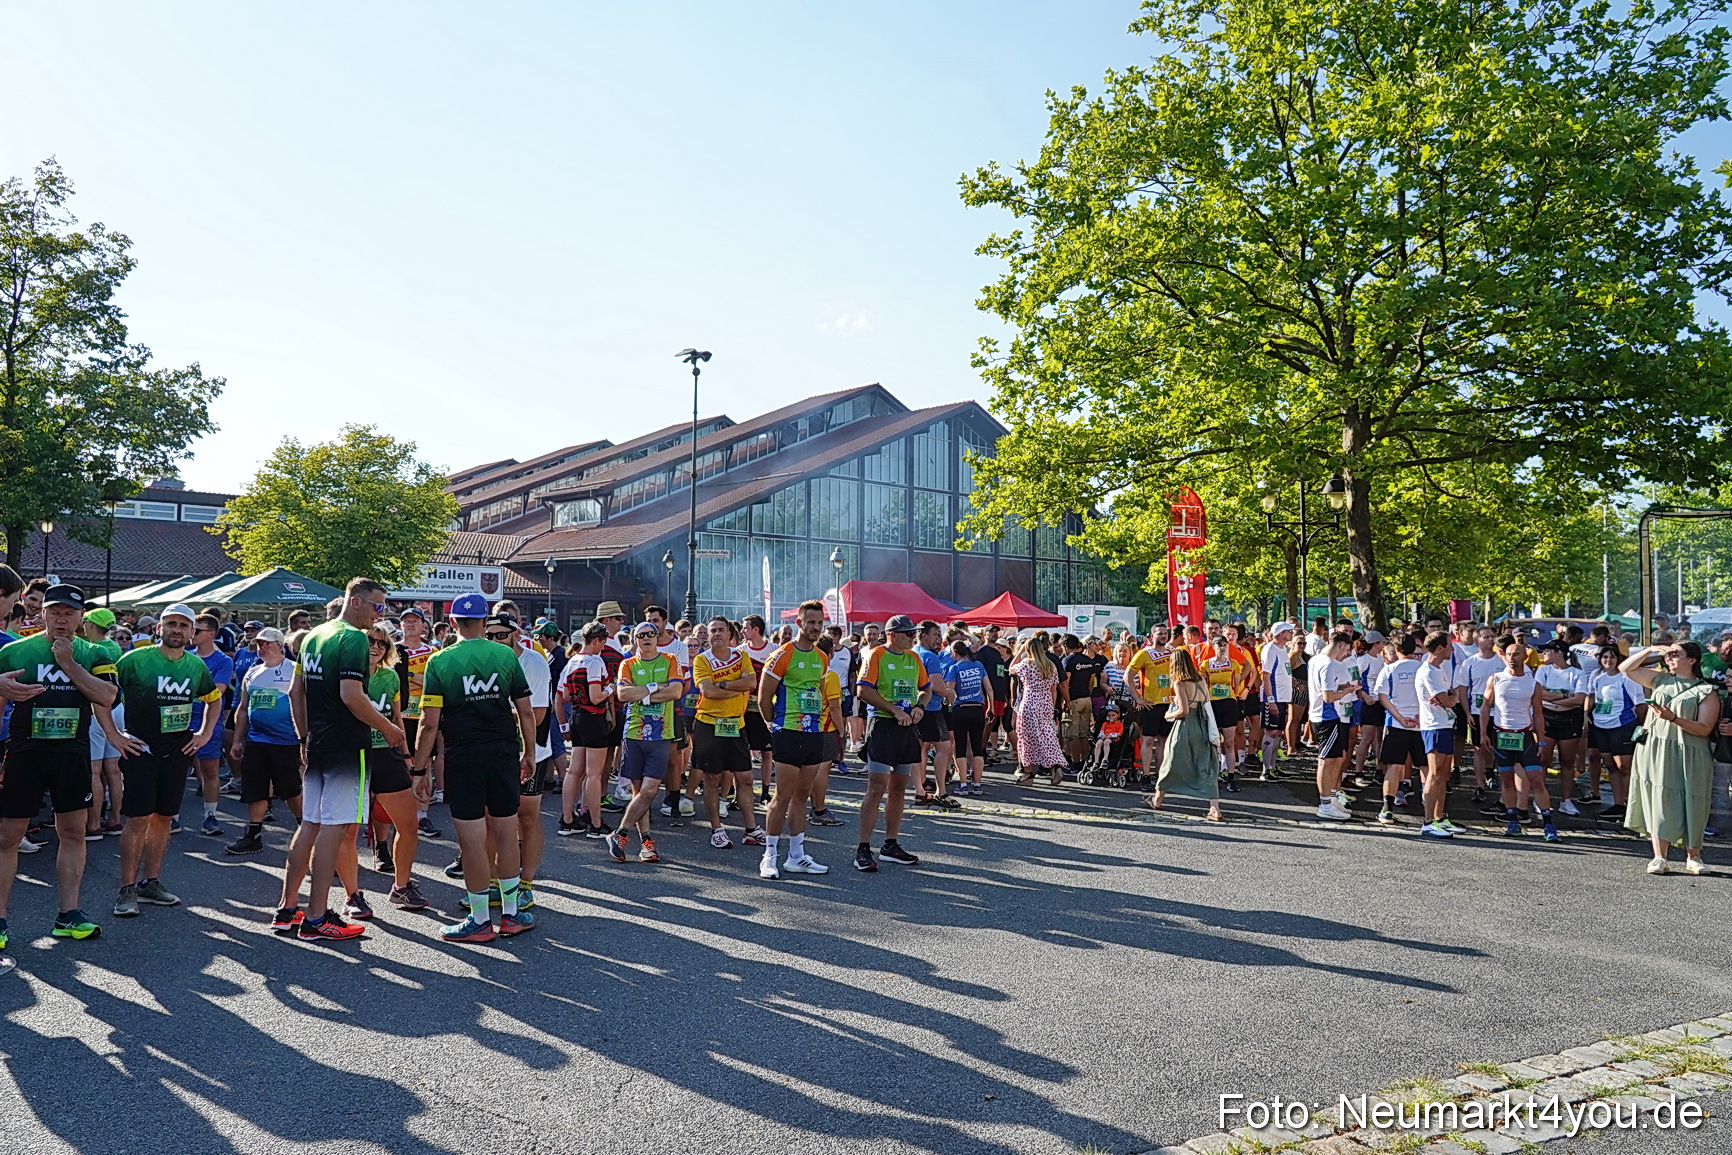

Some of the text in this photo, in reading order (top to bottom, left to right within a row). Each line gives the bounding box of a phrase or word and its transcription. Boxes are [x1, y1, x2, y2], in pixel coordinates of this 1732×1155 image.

[428, 569, 474, 581] Hallen
[713, 669, 732, 680] MAX
[959, 667, 981, 679] DESS
[898, 685, 911, 694] 622
[254, 694, 273, 703] 1188
[475, 693, 500, 701] ENERGIE
[806, 698, 819, 707] 619
[40, 718, 72, 729] 1466
